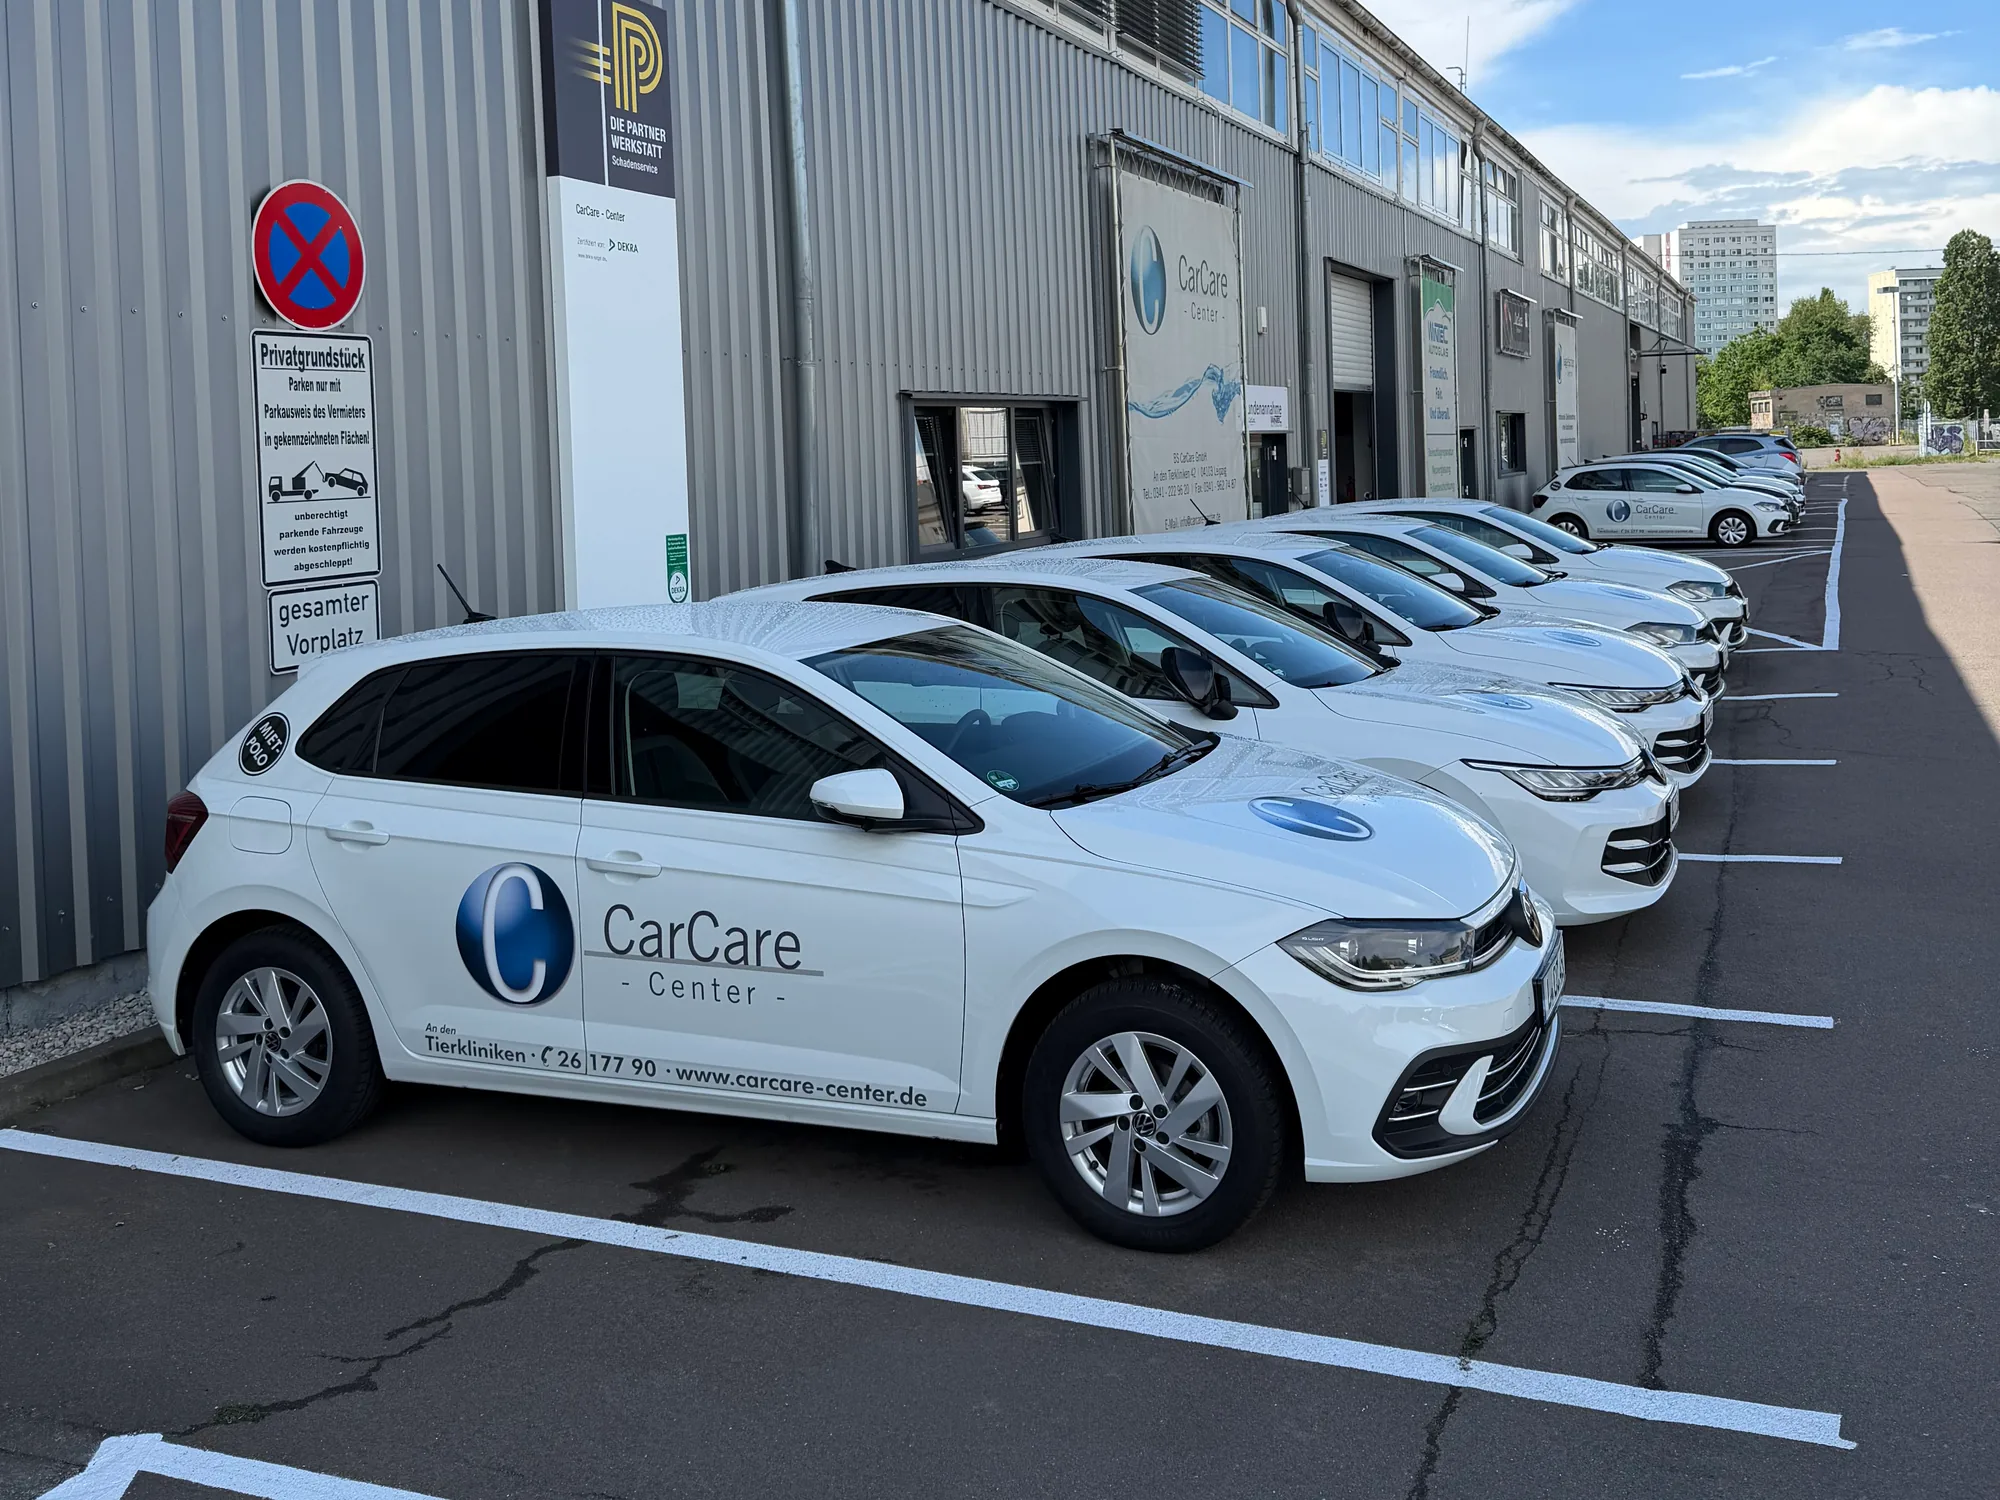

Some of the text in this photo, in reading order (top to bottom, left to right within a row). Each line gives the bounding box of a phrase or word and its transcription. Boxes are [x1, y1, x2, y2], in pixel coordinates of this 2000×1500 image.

[610, 116, 666, 142] DIE PARTNER
[611, 134, 662, 159] WERKSTATT
[612, 155, 658, 174] Schadenservice
[576, 204, 600, 217] CarCare
[606, 209, 625, 222] Center
[618, 241, 638, 253] DEKRA
[1179, 254, 1228, 298] CarCare
[1191, 302, 1218, 322] Center
[260, 343, 365, 372] Privatgrundstück
[289, 377, 341, 392] Parken nur mit
[264, 404, 366, 419] Parkausweis des Vermieters
[264, 431, 370, 450] in gekennzeichneten Flächen!
[294, 509, 348, 520] unberechtigt
[1636, 505, 1674, 514] CarCare
[279, 525, 364, 540] parkende Fahrzeuge
[274, 540, 370, 556] werden kostenpflichtig
[293, 557, 353, 572] abgeschleppt!
[279, 593, 369, 627] gesamter
[287, 628, 364, 656] Vorplatz
[259, 721, 283, 753] MIET-
[246, 736, 268, 766] POLO
[604, 904, 802, 970] CarCare
[649, 971, 756, 1005] Center
[425, 1022, 456, 1035] An den
[425, 1035, 927, 1107] Tierkliniken 26 177 90 www.carcare-center.de
